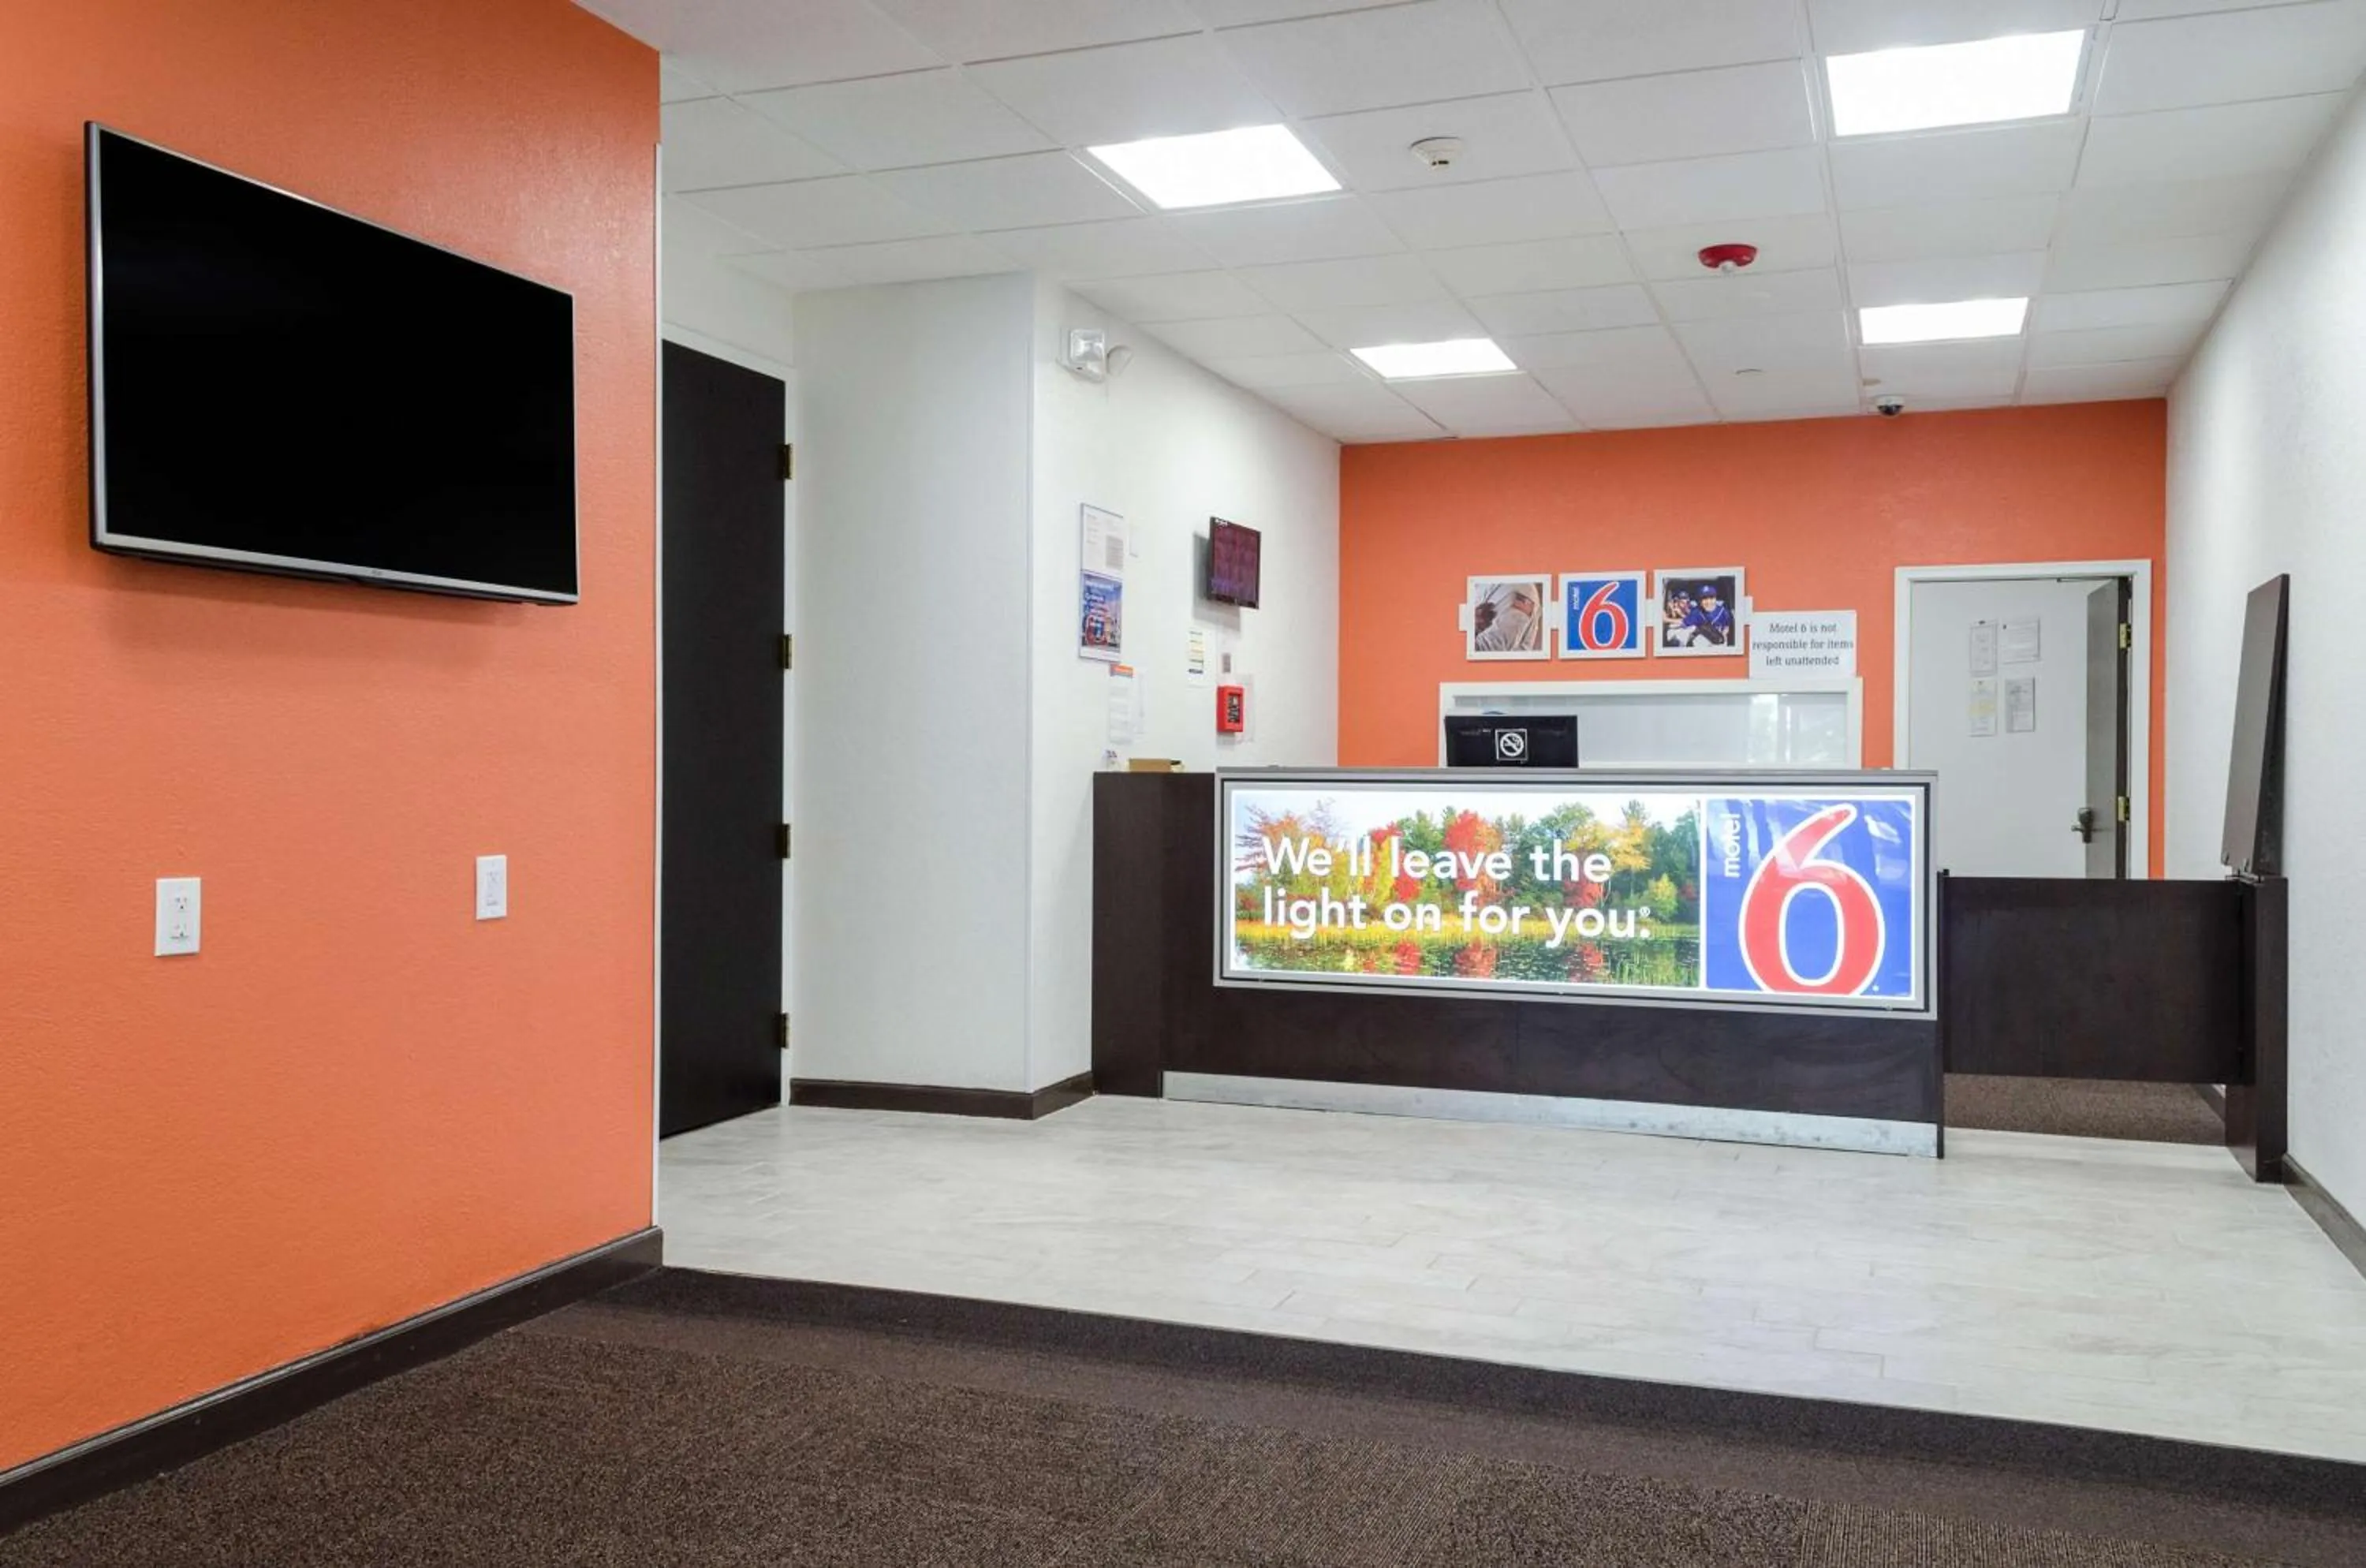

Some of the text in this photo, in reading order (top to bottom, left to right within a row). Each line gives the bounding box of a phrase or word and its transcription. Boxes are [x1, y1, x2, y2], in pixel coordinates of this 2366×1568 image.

[1579, 582, 1629, 651] 6
[1769, 622, 1797, 633] Motel
[1811, 622, 1818, 633] is
[1820, 623, 1837, 633] not
[1752, 639, 1808, 652] responsible
[1811, 639, 1824, 649] for
[1766, 655, 1839, 666] left unattended
[1262, 834, 1613, 883] We'll leave the
[1723, 812, 1741, 879] motel
[1263, 885, 1367, 939] light
[1383, 902, 1442, 931] on
[1458, 890, 1531, 935] for
[1738, 802, 1886, 997] 6
